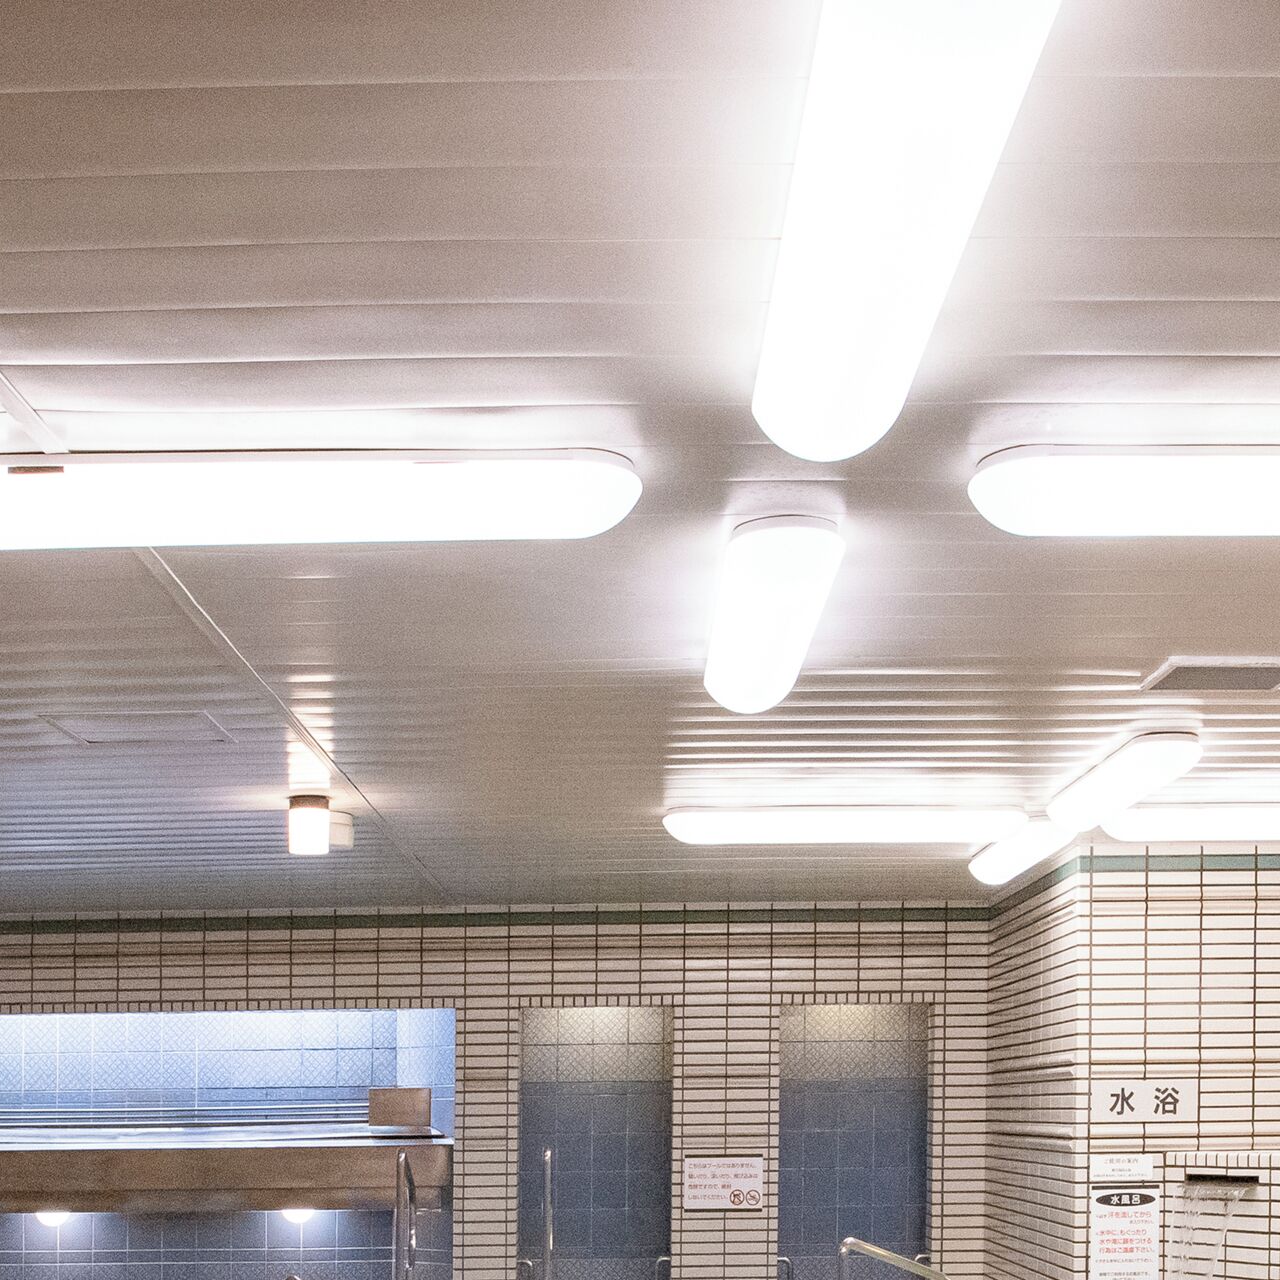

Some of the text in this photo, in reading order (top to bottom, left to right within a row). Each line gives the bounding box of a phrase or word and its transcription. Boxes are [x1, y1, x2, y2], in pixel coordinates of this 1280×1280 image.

[1109, 1087, 1180, 1116] 水浴
[1110, 1194, 1140, 1205] 水風呂
